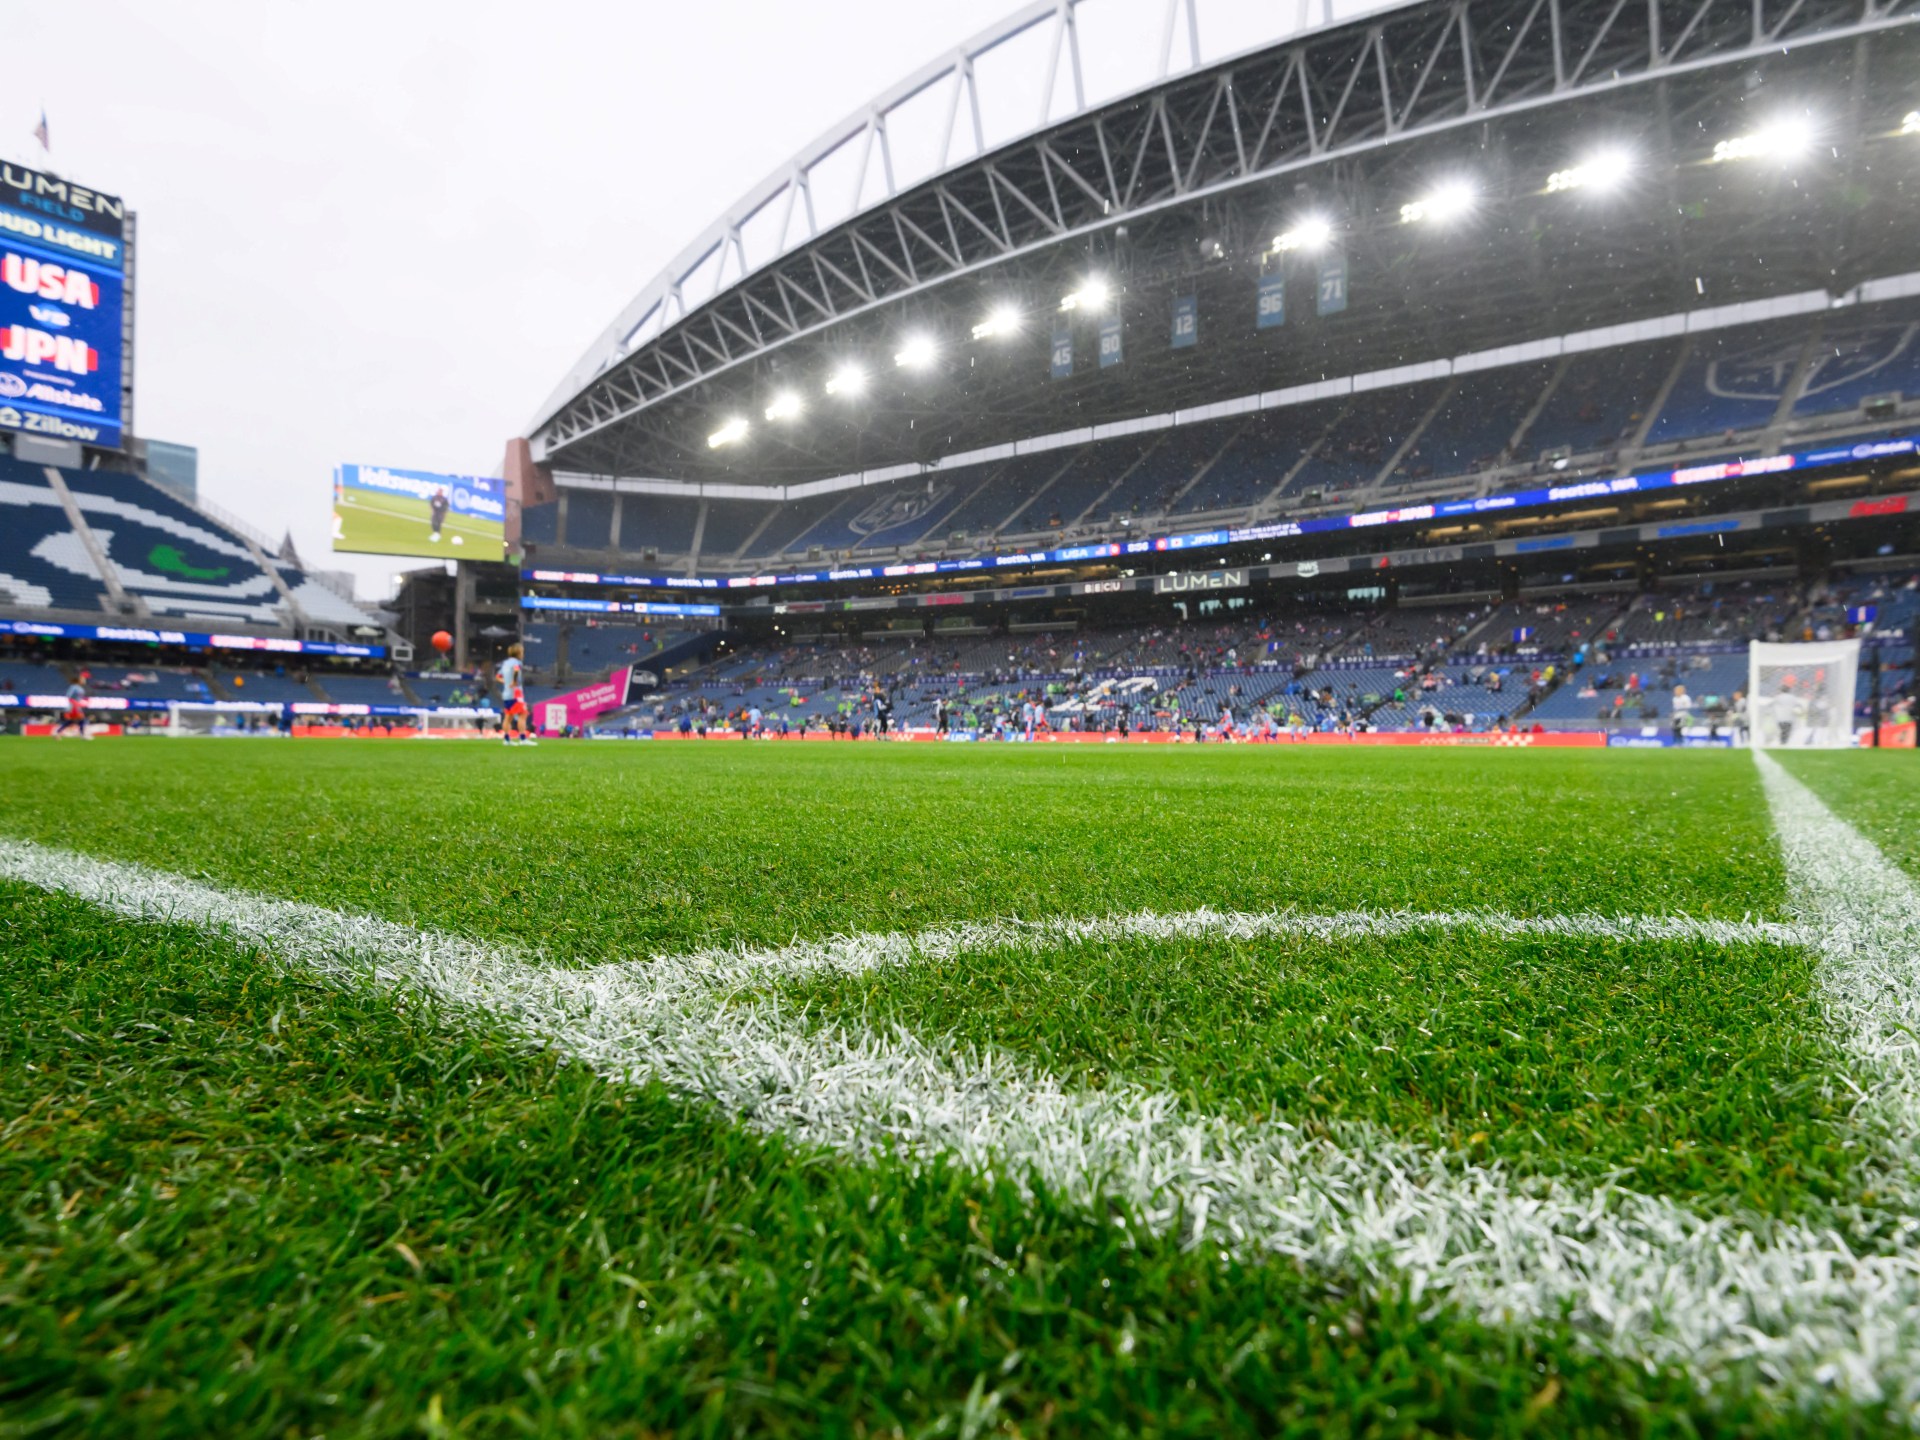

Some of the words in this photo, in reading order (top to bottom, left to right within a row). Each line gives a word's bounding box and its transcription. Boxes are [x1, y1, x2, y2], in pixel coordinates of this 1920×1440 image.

[0, 164, 123, 220] UMEN
[19, 191, 85, 222] FIELD
[0, 211, 42, 237] UD
[43, 224, 117, 259] LIGHT
[5, 252, 95, 310] USA
[1322, 279, 1343, 301] 71
[1175, 314, 1193, 336] 12
[3, 323, 88, 376] JPN
[1053, 347, 1071, 366] 45
[24, 411, 98, 440] Zillow
[1062, 549, 1088, 559] USA
[1190, 534, 1219, 546] JPN
[1160, 571, 1241, 592] LUMEN
